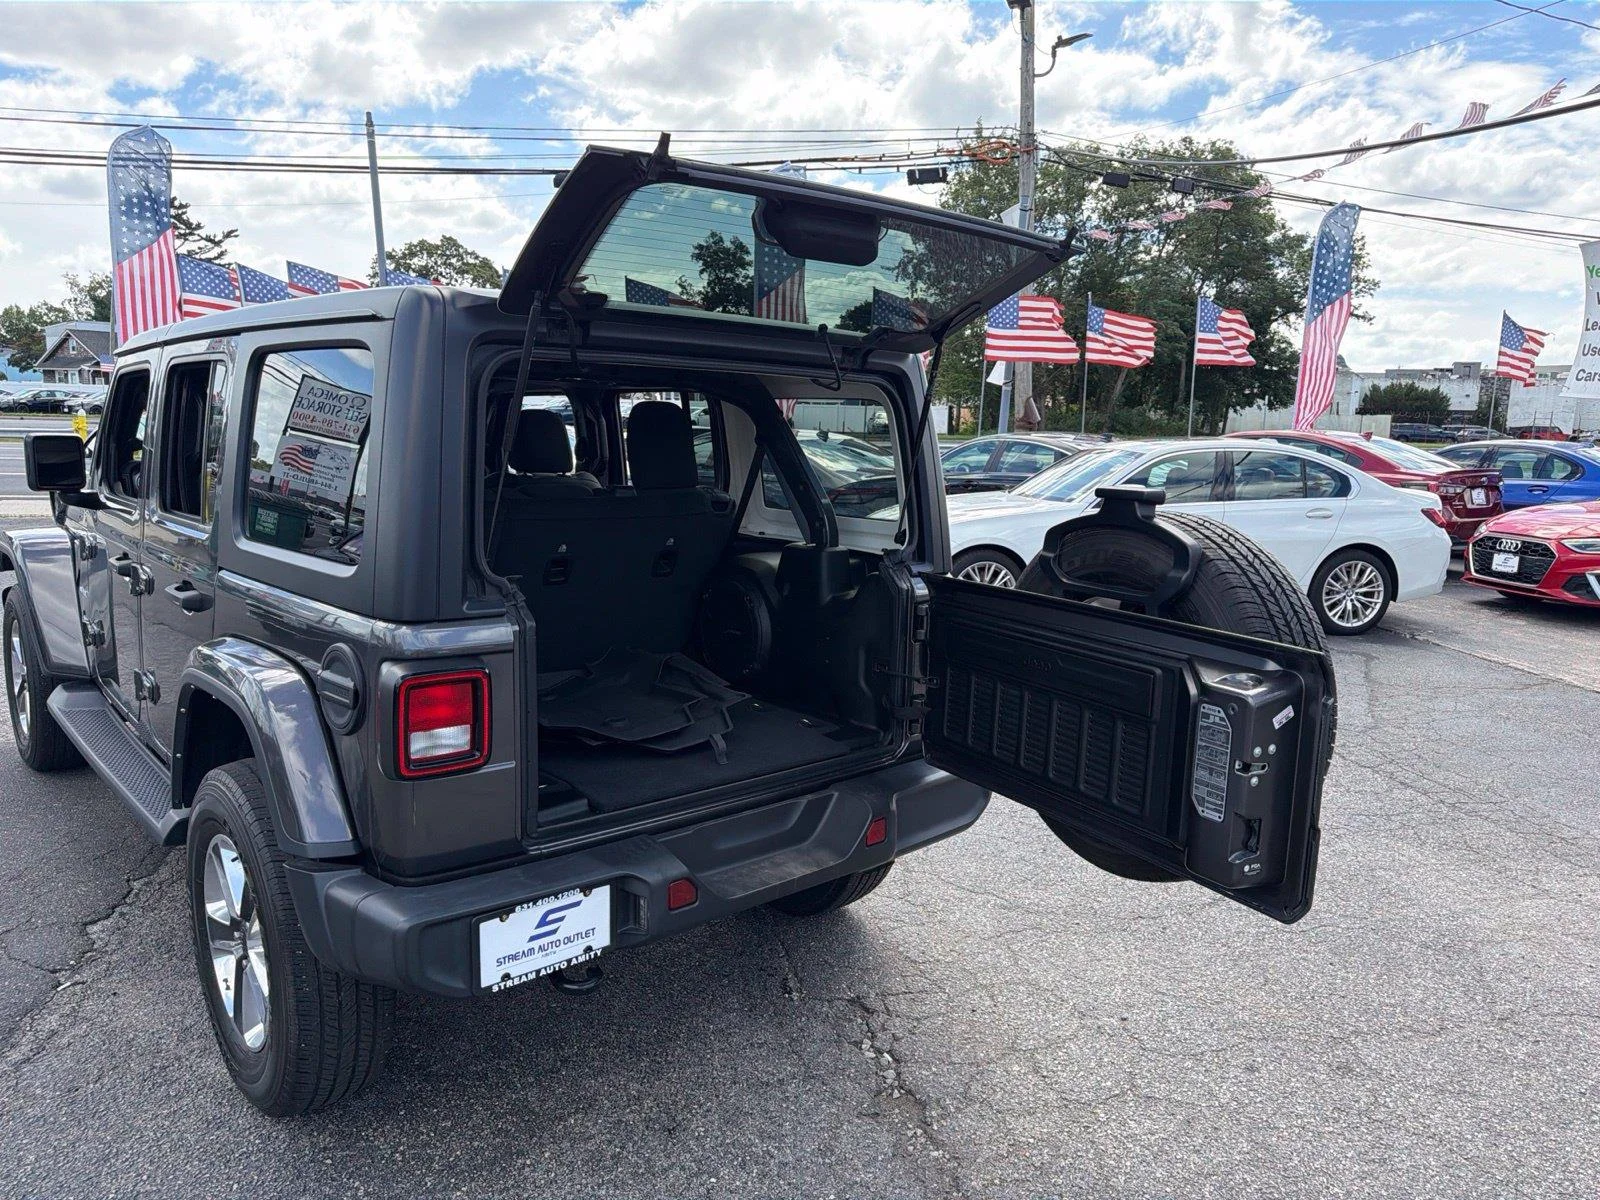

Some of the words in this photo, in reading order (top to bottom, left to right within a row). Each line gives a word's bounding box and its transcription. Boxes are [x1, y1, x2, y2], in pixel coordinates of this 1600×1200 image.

[515, 888, 581, 913] 631.400.1200
[496, 947, 536, 967] STREAM
[537, 938, 561, 955] AUTO
[562, 927, 597, 946] OUTLET
[491, 972, 536, 993] STREAM
[539, 961, 568, 976] AUTO
[570, 948, 603, 966] AMITY
